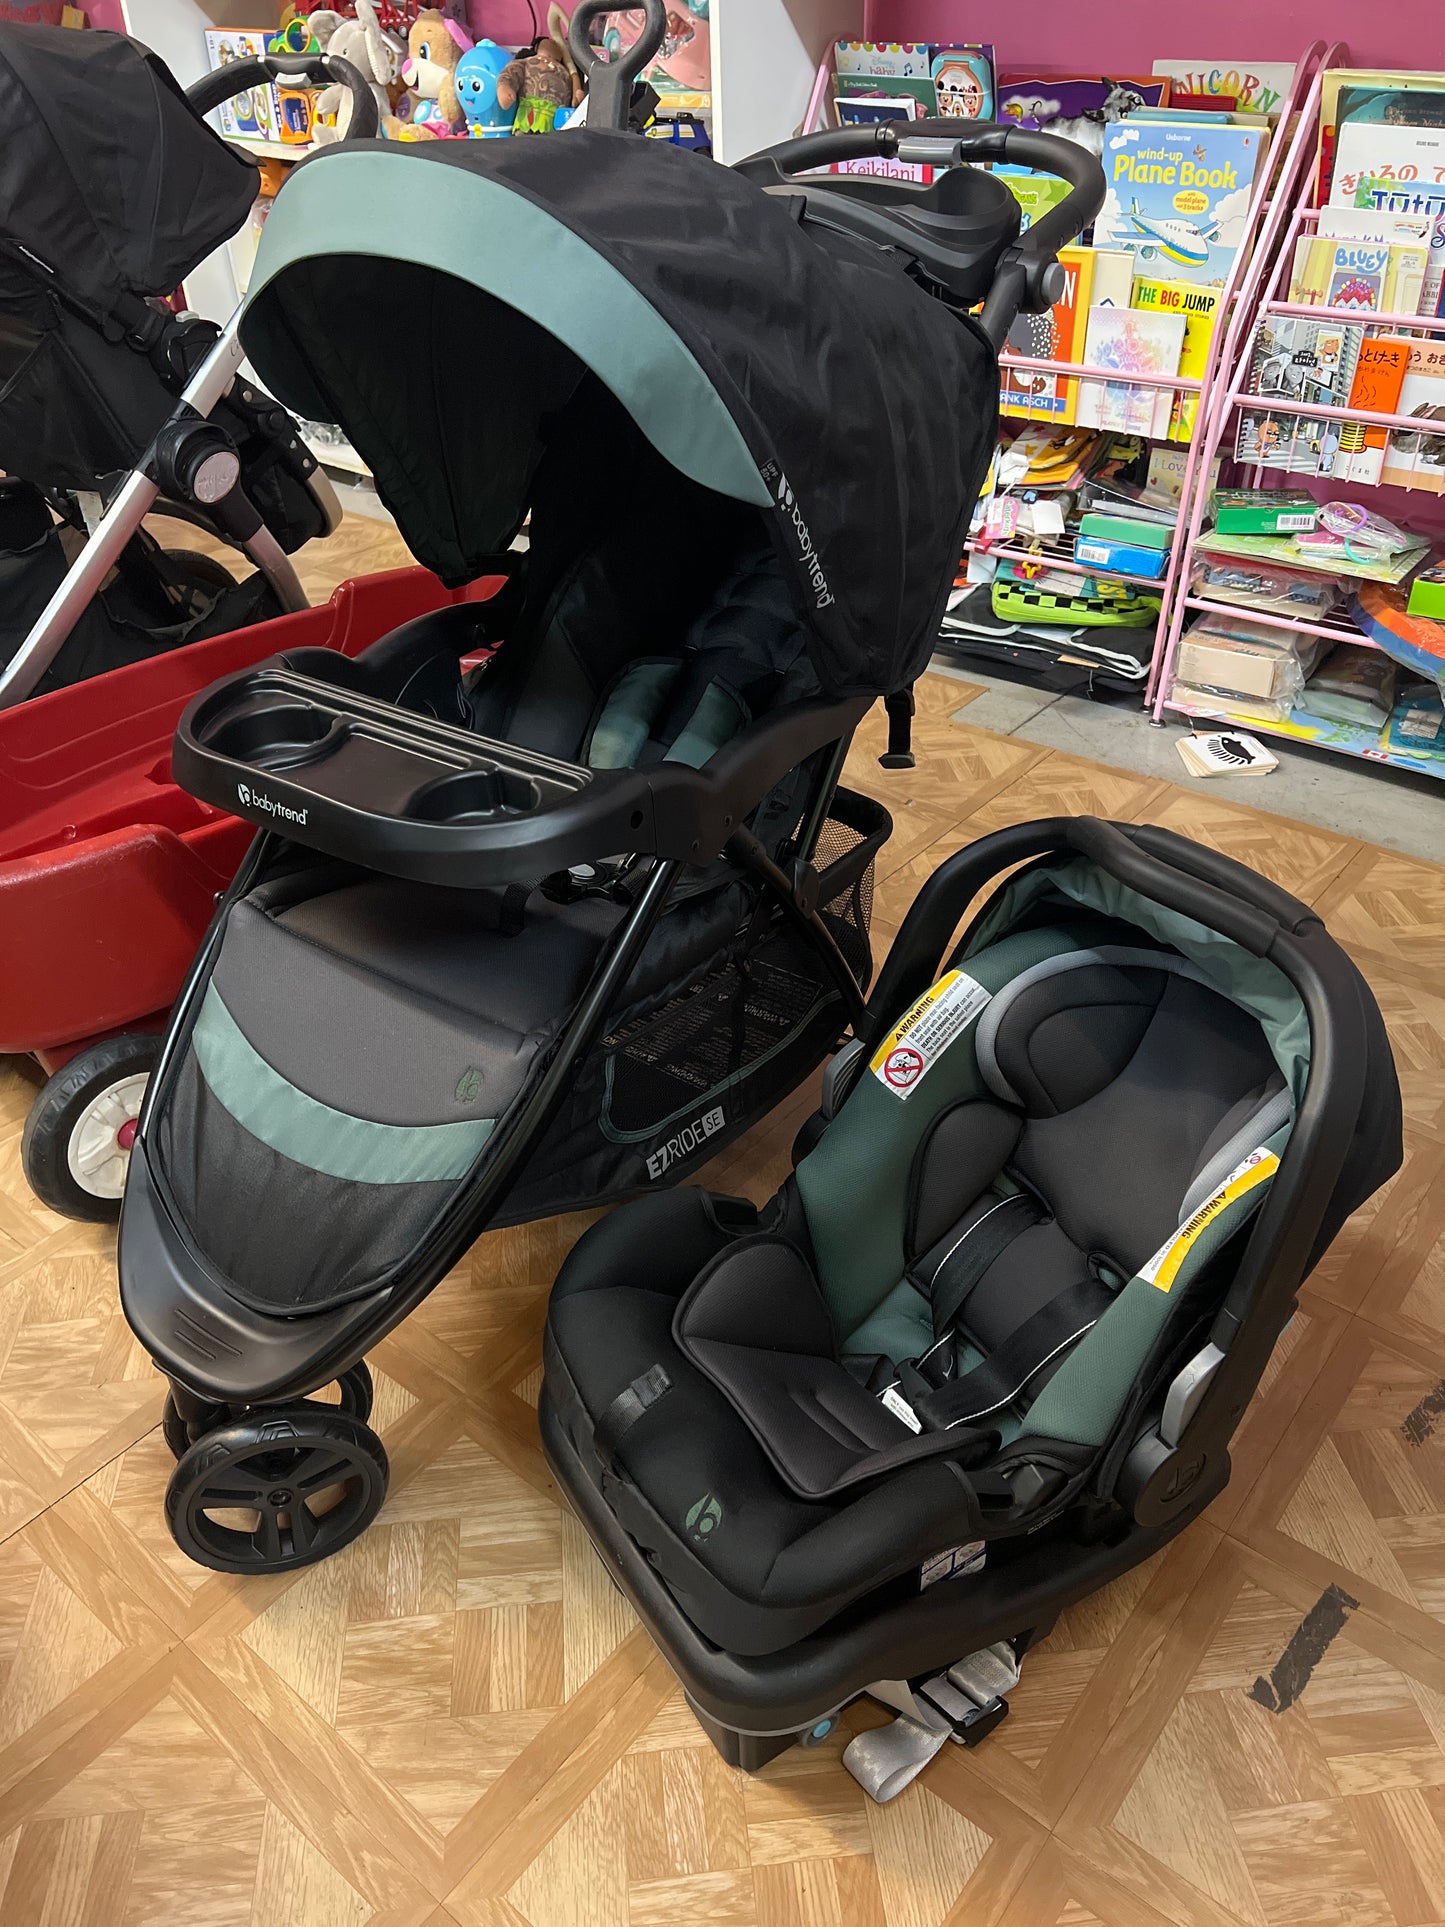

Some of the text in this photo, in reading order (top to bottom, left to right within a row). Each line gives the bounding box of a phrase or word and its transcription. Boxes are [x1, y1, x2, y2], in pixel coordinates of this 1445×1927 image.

[1165, 133, 1192, 142] Usborne
[1137, 147, 1184, 165] wind-up
[1113, 154, 1238, 189] Plane Book
[1191, 197, 1207, 205] plane
[1334, 247, 1388, 275] BLUEY
[1137, 286, 1215, 312] THE BIG JUMP
[1022, 396, 1048, 408] ASCH
[767, 462, 779, 477] UPF
[792, 502, 836, 609] babytrend
[252, 788, 307, 825] babytrend
[900, 996, 935, 1034] WARNING
[920, 1036, 932, 1049] DEATH
[930, 1030, 938, 1038] OR
[935, 1016, 951, 1032] SERIOUS
[948, 1003, 961, 1018] INJURY
[926, 1045, 934, 1053] The
[932, 1037, 941, 1046] back
[939, 1028, 948, 1038] seat
[954, 1009, 966, 1022] safest
[963, 1001, 974, 1012] place
[909, 1031, 917, 1040] DO
[914, 1024, 923, 1034] NOT
[915, 1033, 926, 1044] front
[923, 1026, 931, 1036] seat
[930, 1018, 938, 1028] with
[1181, 1198, 1221, 1239] WARNING
